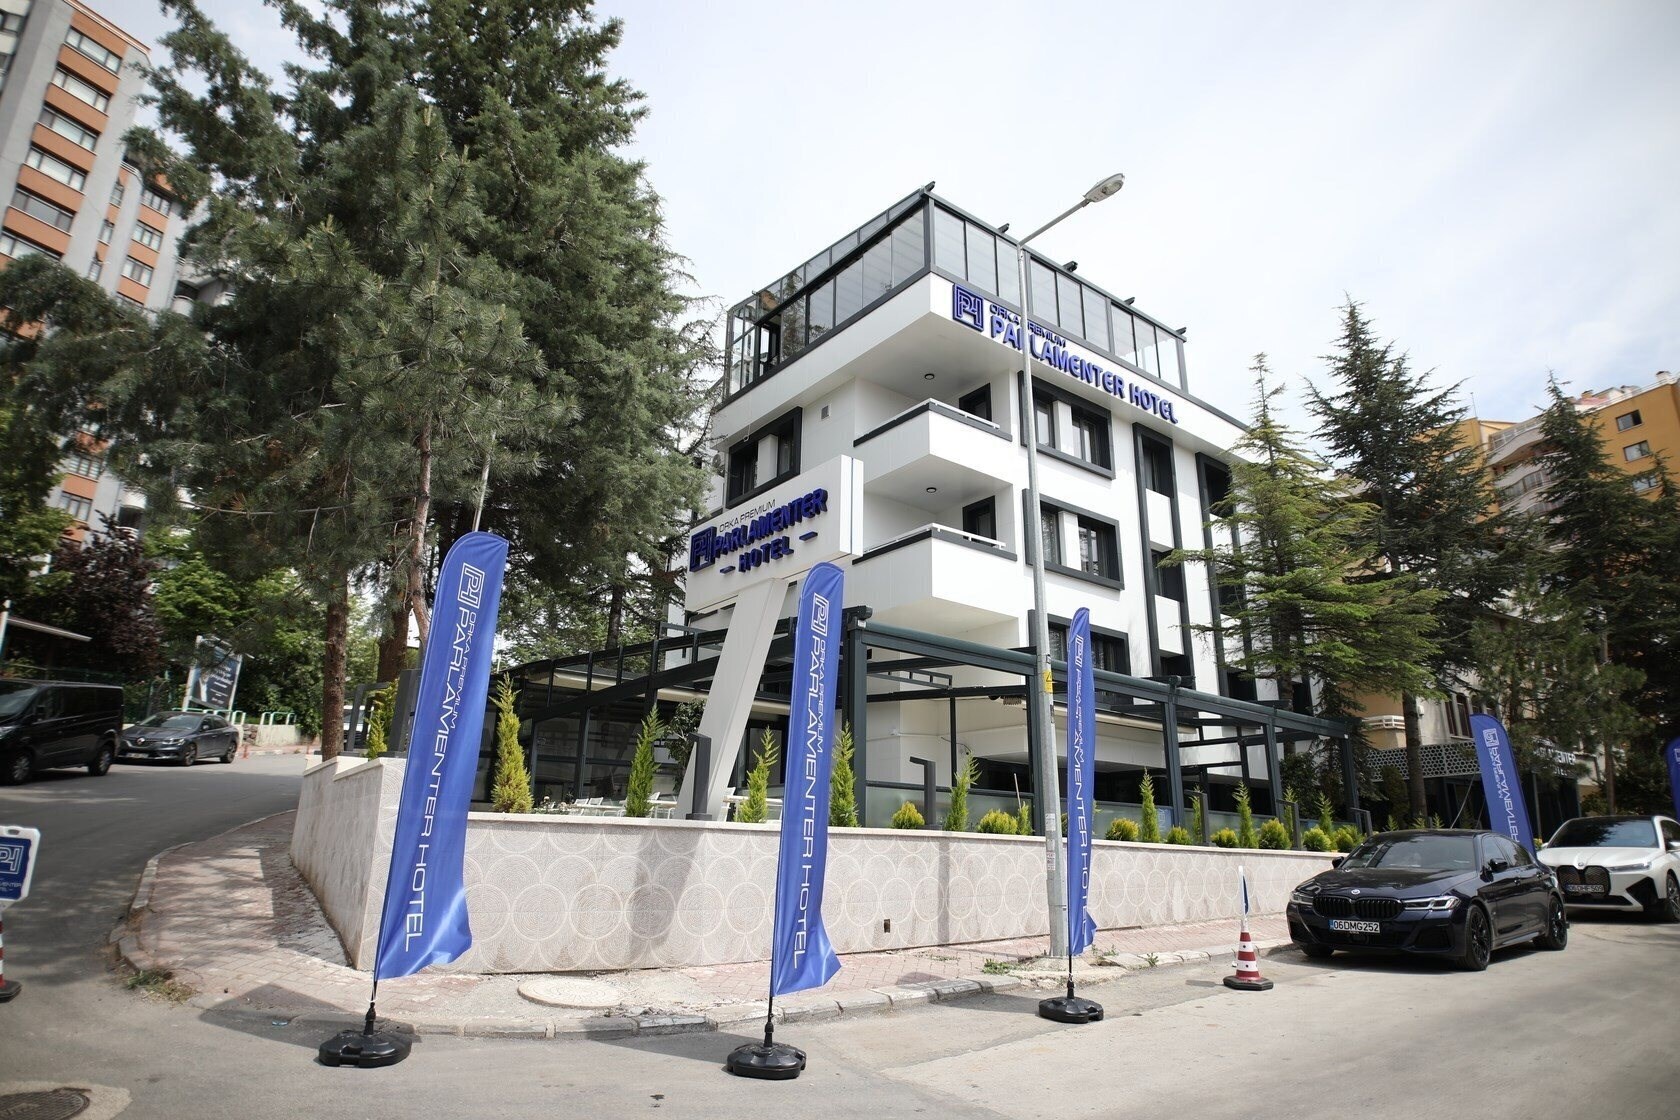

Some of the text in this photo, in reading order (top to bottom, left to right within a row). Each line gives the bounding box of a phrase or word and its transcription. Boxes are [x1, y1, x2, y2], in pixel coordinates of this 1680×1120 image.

[990, 303, 1066, 348] ORKA REMIUM
[1129, 383, 1178, 424] HOTEL
[715, 488, 829, 558] PARLAMENTER
[719, 499, 776, 532] ORKA PREMIUM
[739, 536, 795, 572] HOTEL
[450, 612, 477, 729] ORKA PREMIUM
[816, 640, 826, 753] ORKA PREMIUM
[405, 606, 470, 952] PARLAMENTER HOTEL
[794, 635, 822, 969] PARLAMENTER HOTEL
[1333, 920, 1379, 932] 06DMG252
